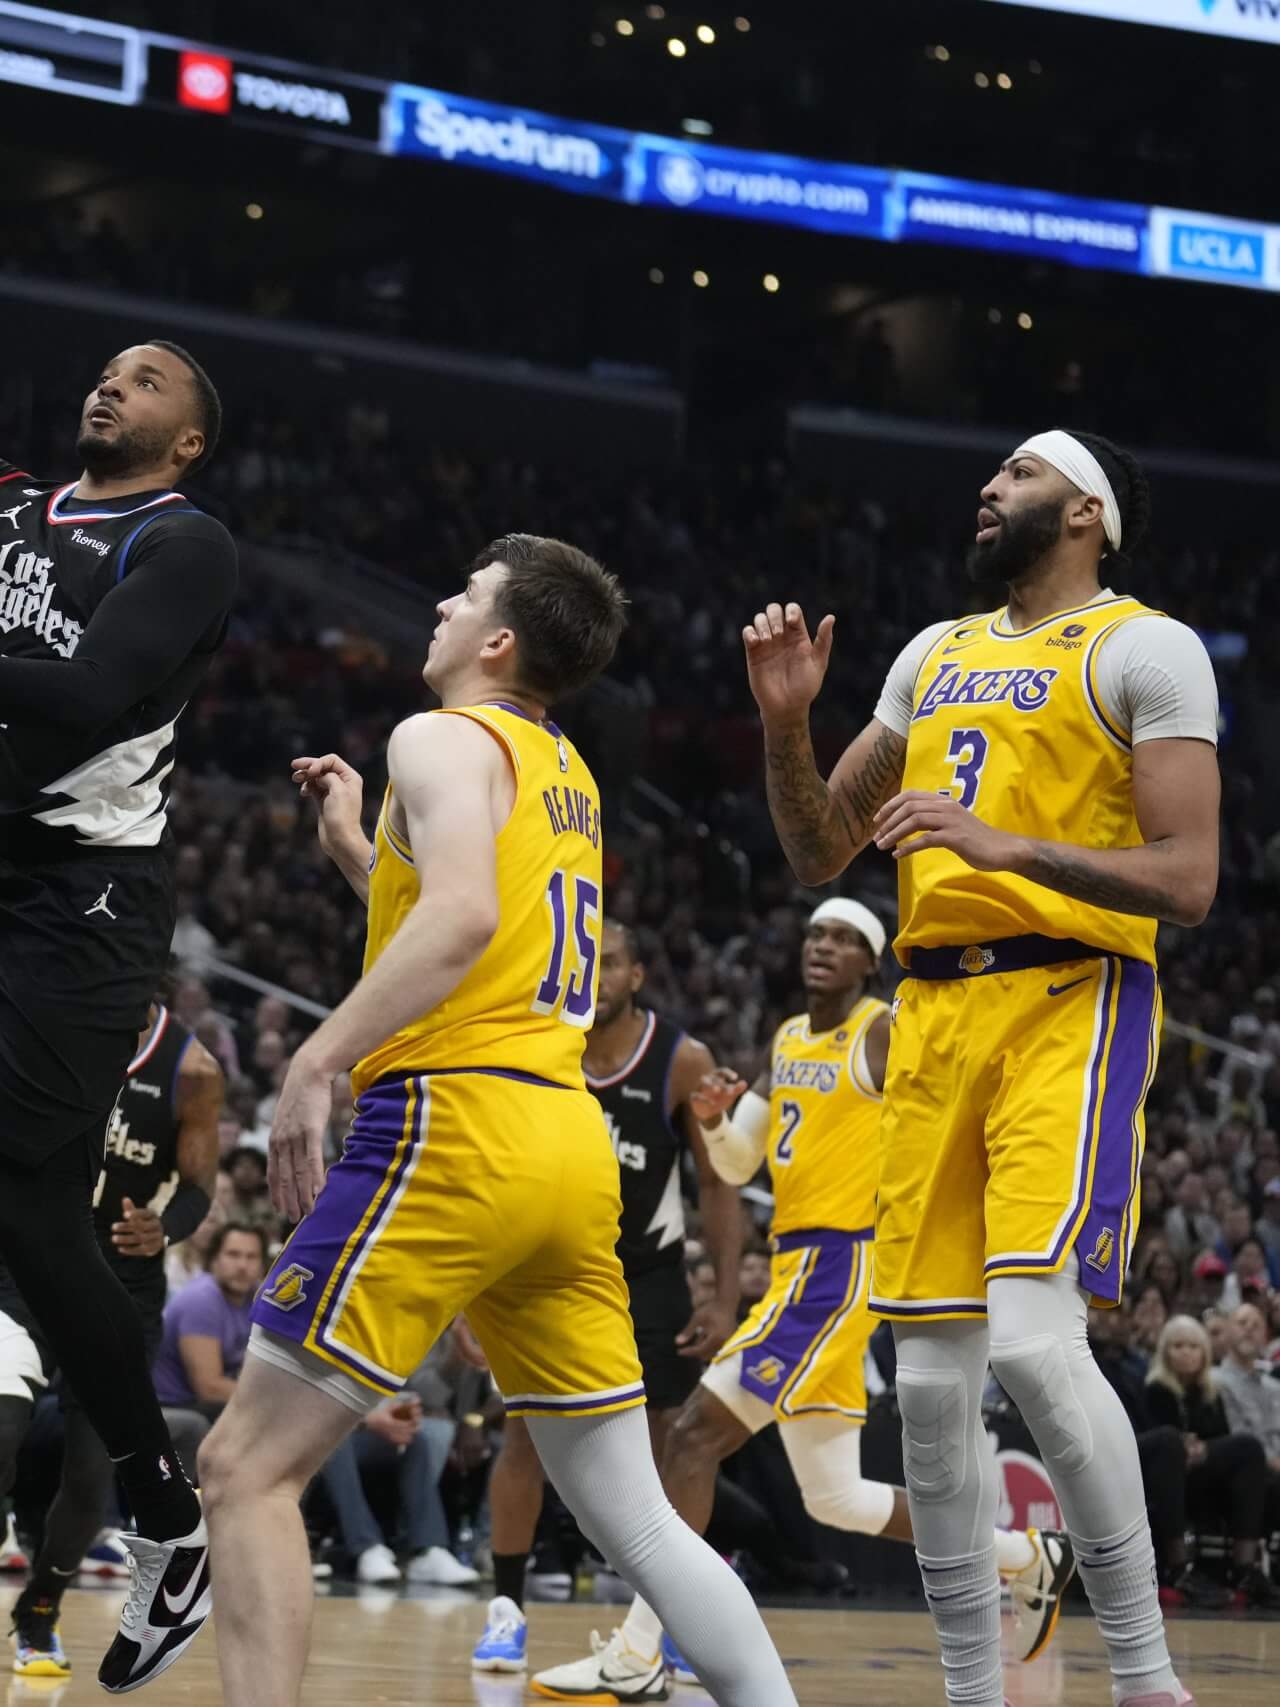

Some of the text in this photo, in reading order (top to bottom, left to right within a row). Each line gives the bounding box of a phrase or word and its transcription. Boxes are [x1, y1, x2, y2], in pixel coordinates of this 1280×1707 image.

[234, 72, 351, 125] TOYOTA
[415, 101, 603, 178] Spectrum
[703, 166, 869, 218] crypto.com
[910, 195, 1138, 253] AMERICAN EXPRESS
[1179, 228, 1256, 274] UCLA
[71, 527, 111, 557] honey
[1045, 636, 1083, 651] bibigo
[910, 662, 1059, 723] LAKERS
[937, 727, 989, 812] 3
[542, 785, 600, 850] REAVES
[529, 867, 599, 1029] 15
[776, 1101, 803, 1166] 2
